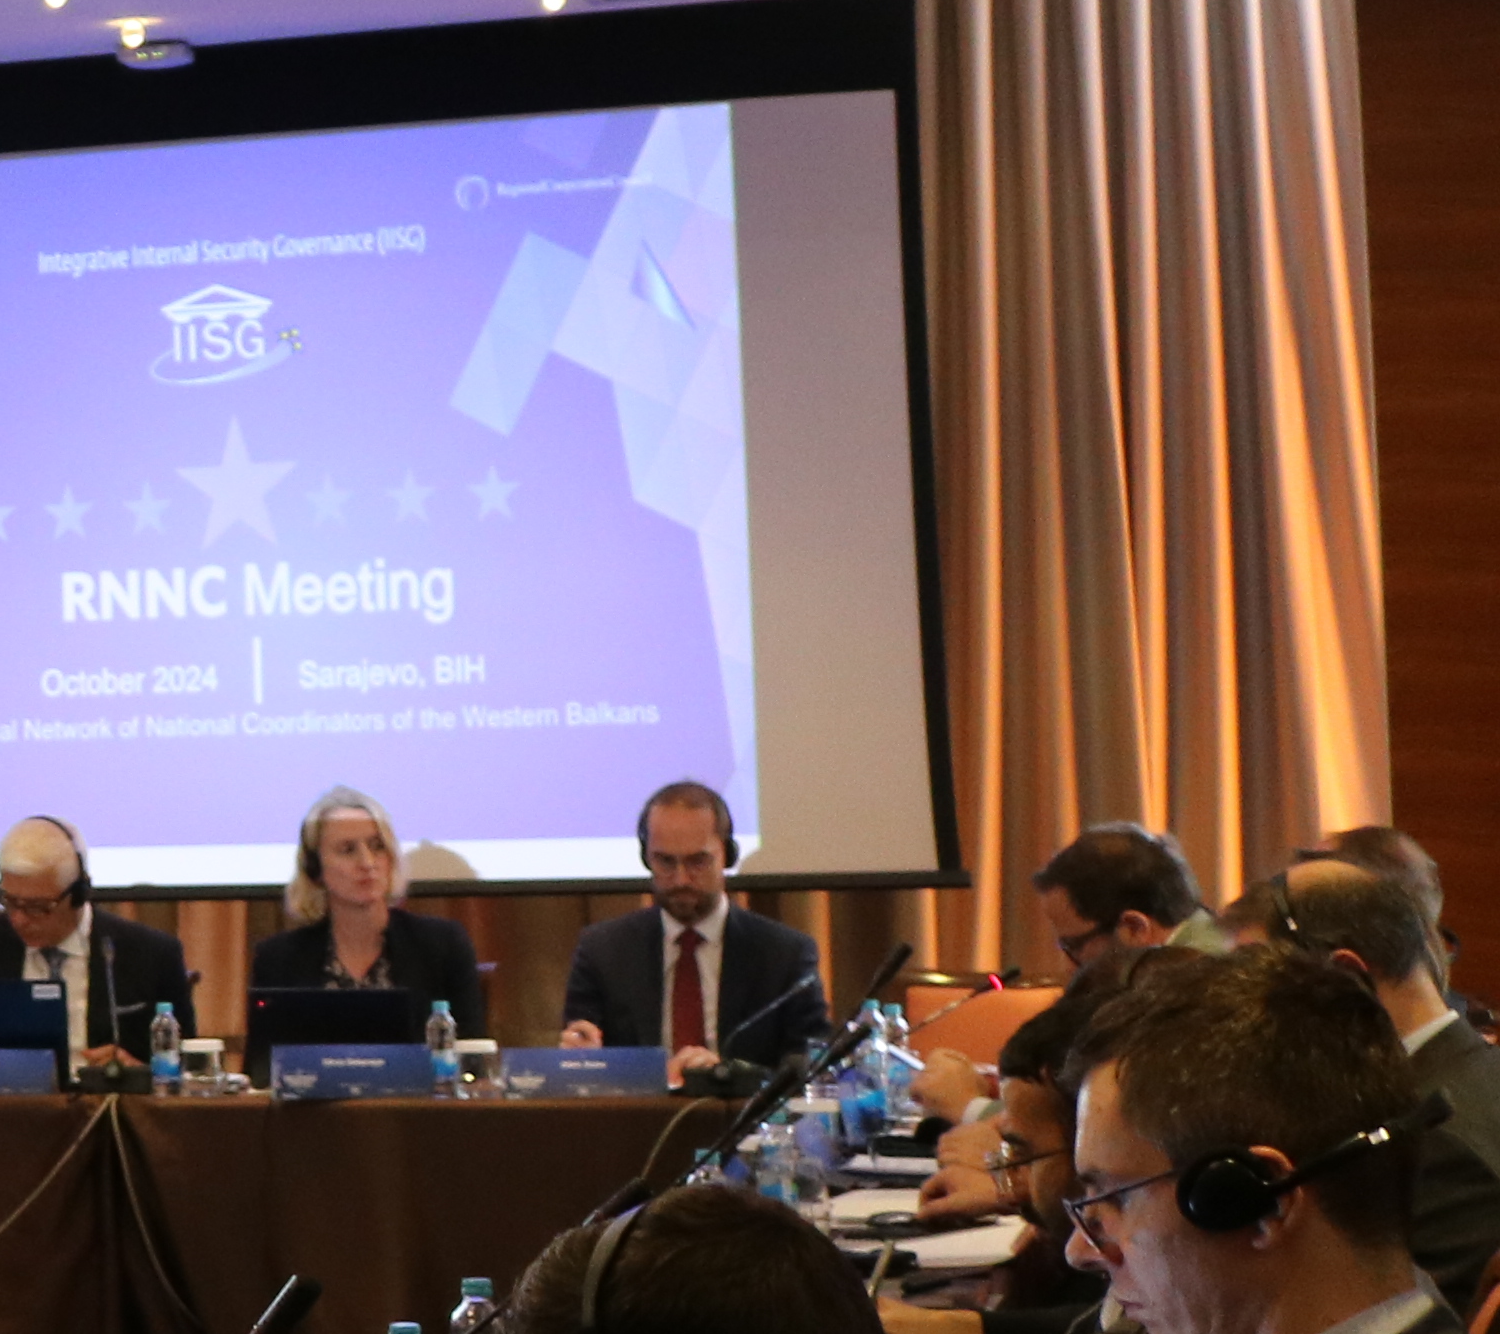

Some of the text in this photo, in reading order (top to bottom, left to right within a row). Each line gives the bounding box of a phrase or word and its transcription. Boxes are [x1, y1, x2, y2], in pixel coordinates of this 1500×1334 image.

[38, 225, 427, 278] Integrative Internal Security Governance (IISG)
[173, 320, 266, 363] IISG
[61, 557, 454, 624] RNNC Meeting
[40, 664, 218, 697] October 2024
[299, 654, 486, 693] Sarajevo, BIH
[24, 716, 111, 741] Network
[118, 715, 140, 738] of
[145, 713, 236, 738] National
[241, 710, 385, 735] Coordinators
[392, 708, 414, 731] of
[420, 706, 455, 730] the
[462, 704, 559, 729] Western
[566, 700, 660, 726] Balkans
